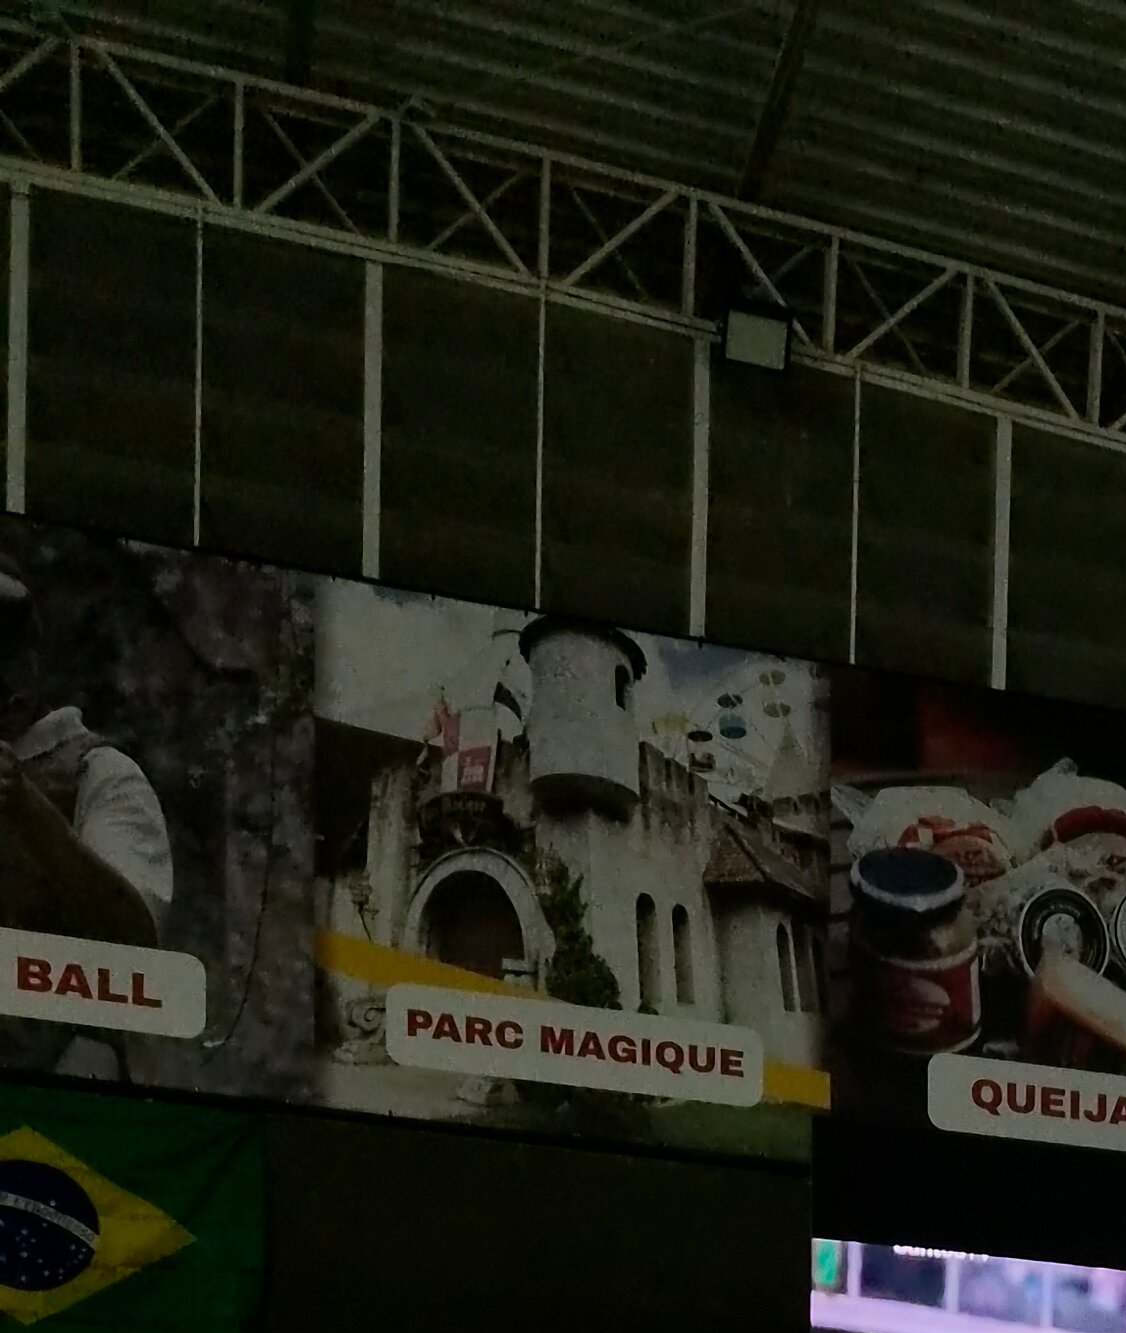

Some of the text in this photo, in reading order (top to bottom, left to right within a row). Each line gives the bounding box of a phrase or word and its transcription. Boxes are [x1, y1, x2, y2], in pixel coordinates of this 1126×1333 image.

[17, 956, 162, 1008] BALL
[407, 1009, 744, 1077] PARC MAGIQUE
